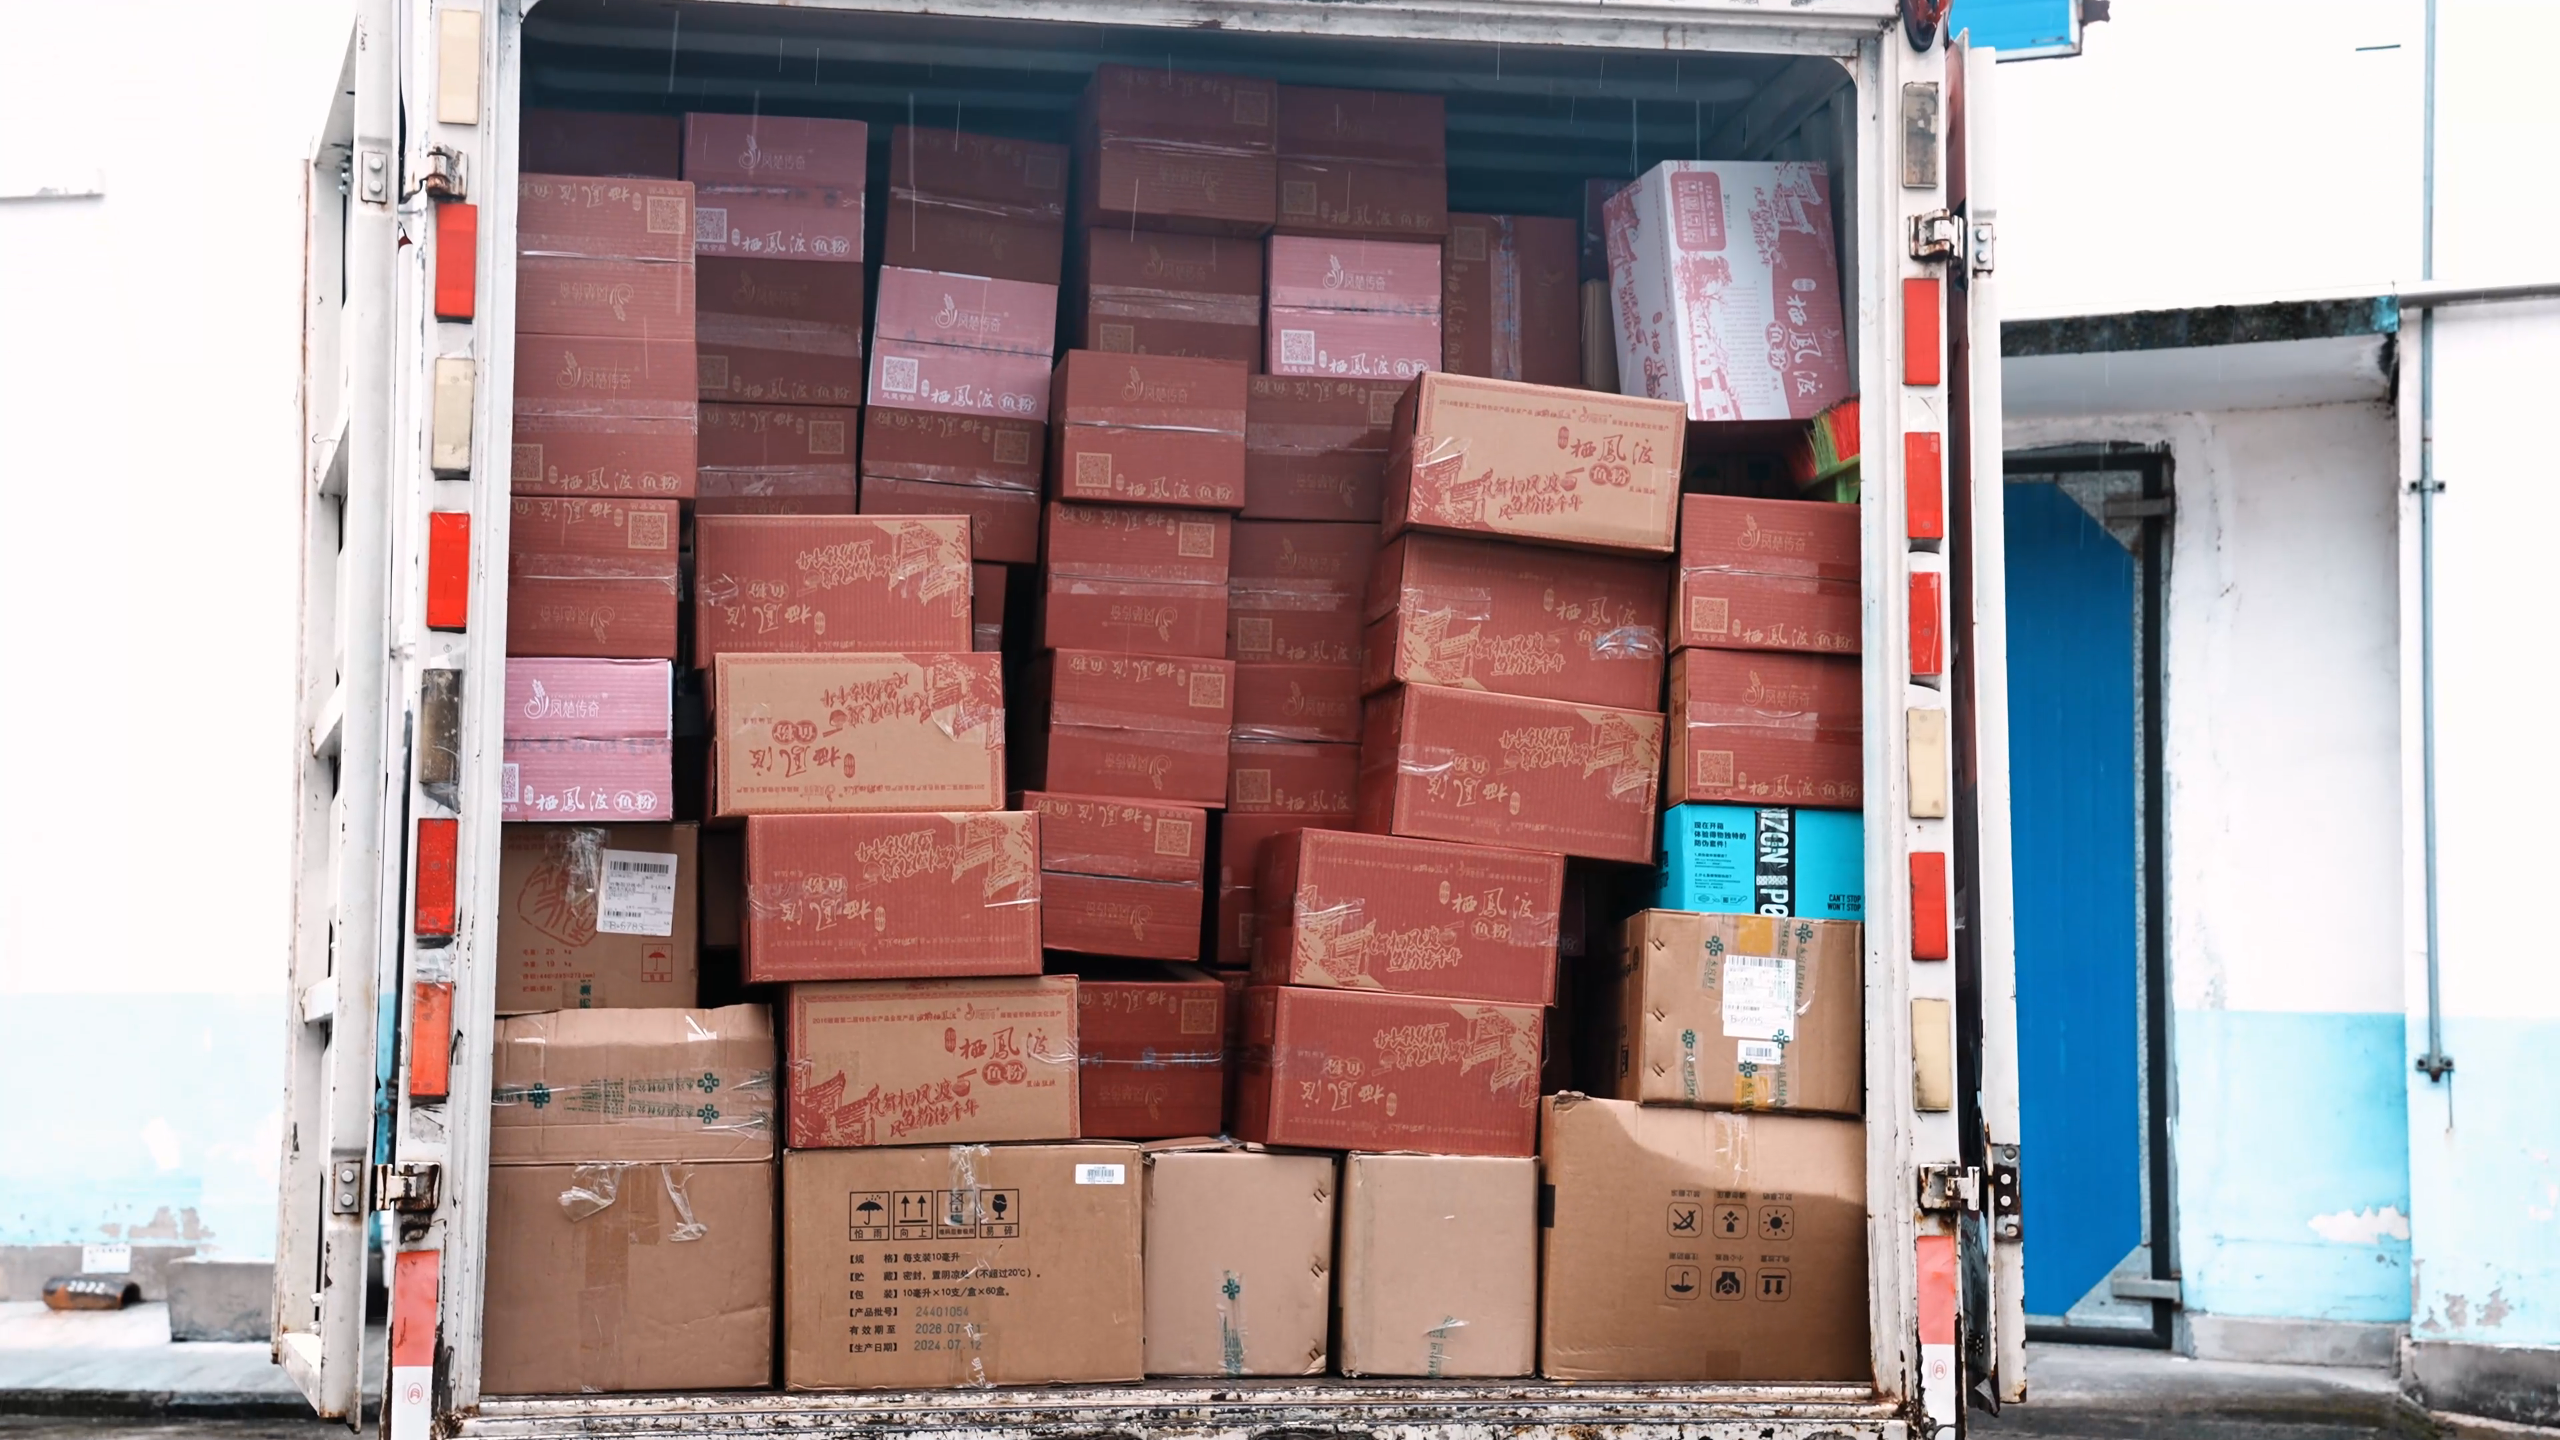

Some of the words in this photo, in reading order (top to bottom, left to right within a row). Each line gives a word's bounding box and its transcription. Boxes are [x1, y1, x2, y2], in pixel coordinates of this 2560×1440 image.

[1766, 320, 1792, 372] 鱼粉
[1588, 463, 1632, 489] 鱼粉
[550, 700, 600, 718] 凤楚传奇
[772, 719, 818, 746] 鱼粉
[1694, 821, 1724, 830] 现在开箱
[1694, 830, 1747, 841] 体验得物独特的
[1828, 893, 1846, 903] CAN'T
[1847, 894, 1862, 904] STOP
[1827, 902, 1846, 911] WON'T
[1847, 903, 1862, 912] STOP
[981, 1059, 1027, 1086] 鱼粉
[902, 1251, 960, 1264] 每支装10毫升
[850, 1306, 899, 1318] 【产品批号】
[915, 1305, 970, 1318] 24401054
[849, 1324, 896, 1336] 有效期至
[850, 1342, 899, 1354] 【生产日期】
[914, 1338, 983, 1351] 2024.07.12
